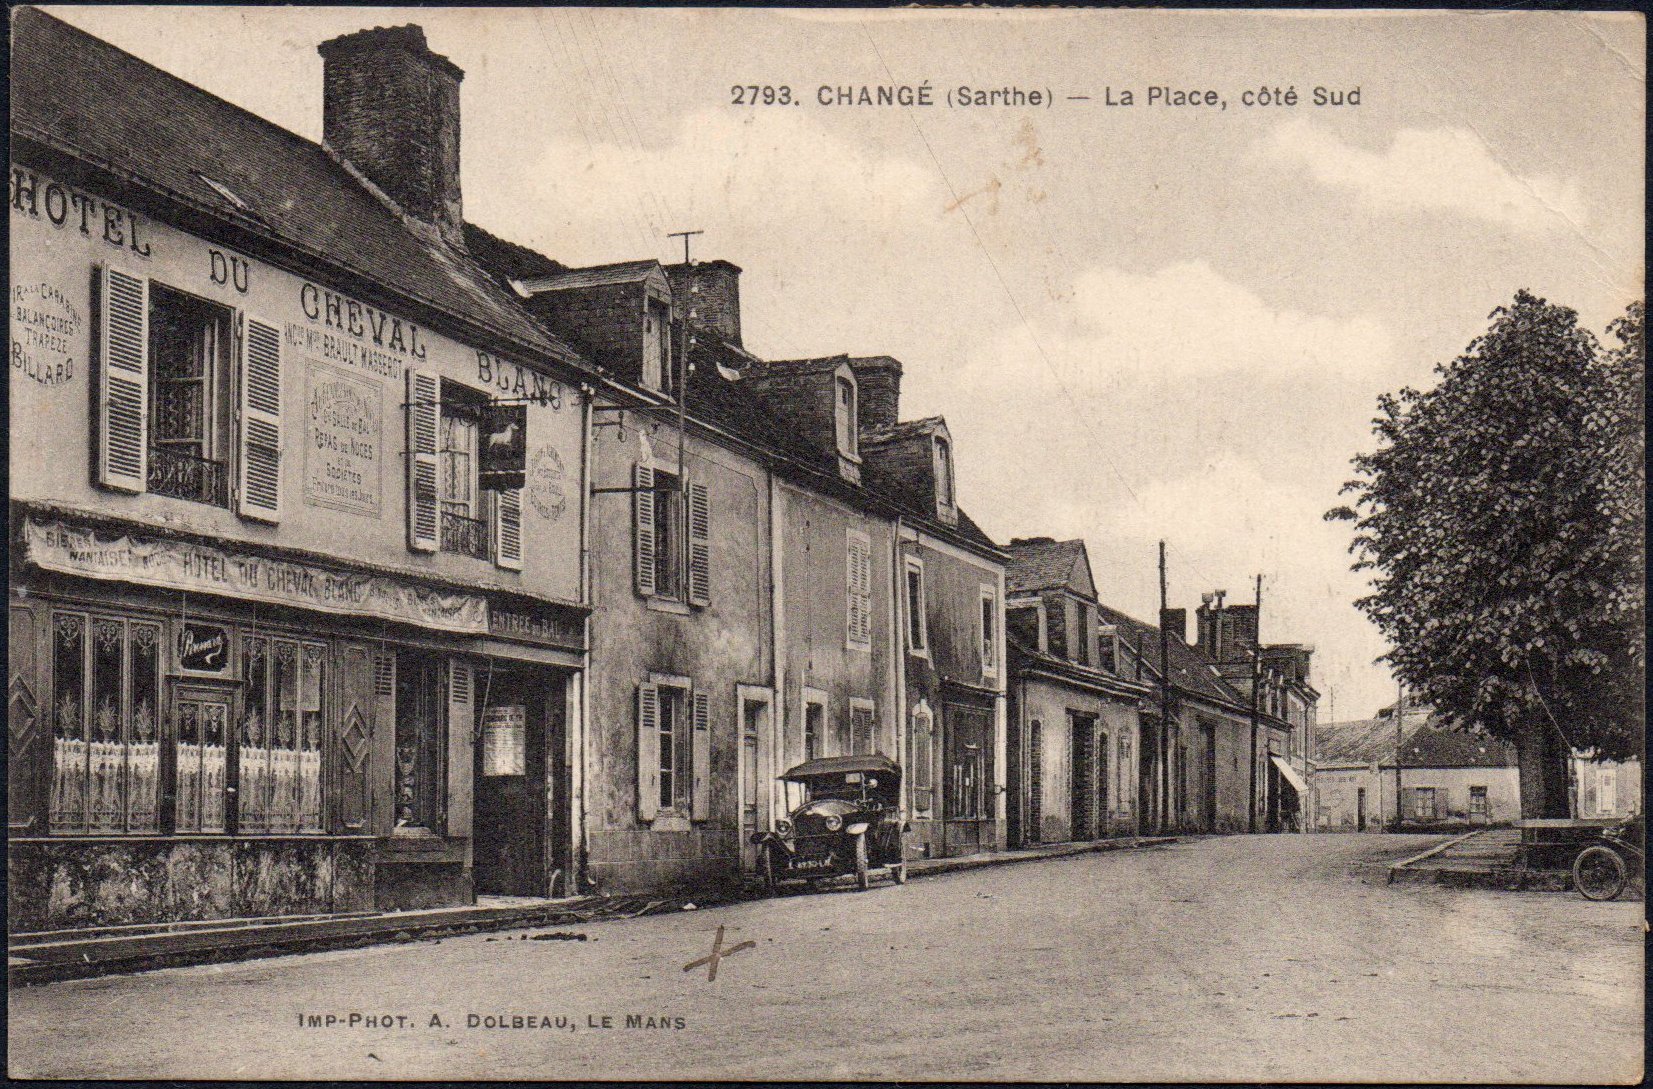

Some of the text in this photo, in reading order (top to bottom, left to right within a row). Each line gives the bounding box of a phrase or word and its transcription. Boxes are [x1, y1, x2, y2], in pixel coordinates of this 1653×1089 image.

[12, 167, 562, 411] HOTEL DU CHEVAL BLANC
[11, 337, 74, 386] BILLARD
[183, 552, 227, 583] HOTEL
[266, 565, 314, 598] CHEVAL
[323, 576, 361, 603] BLANC
